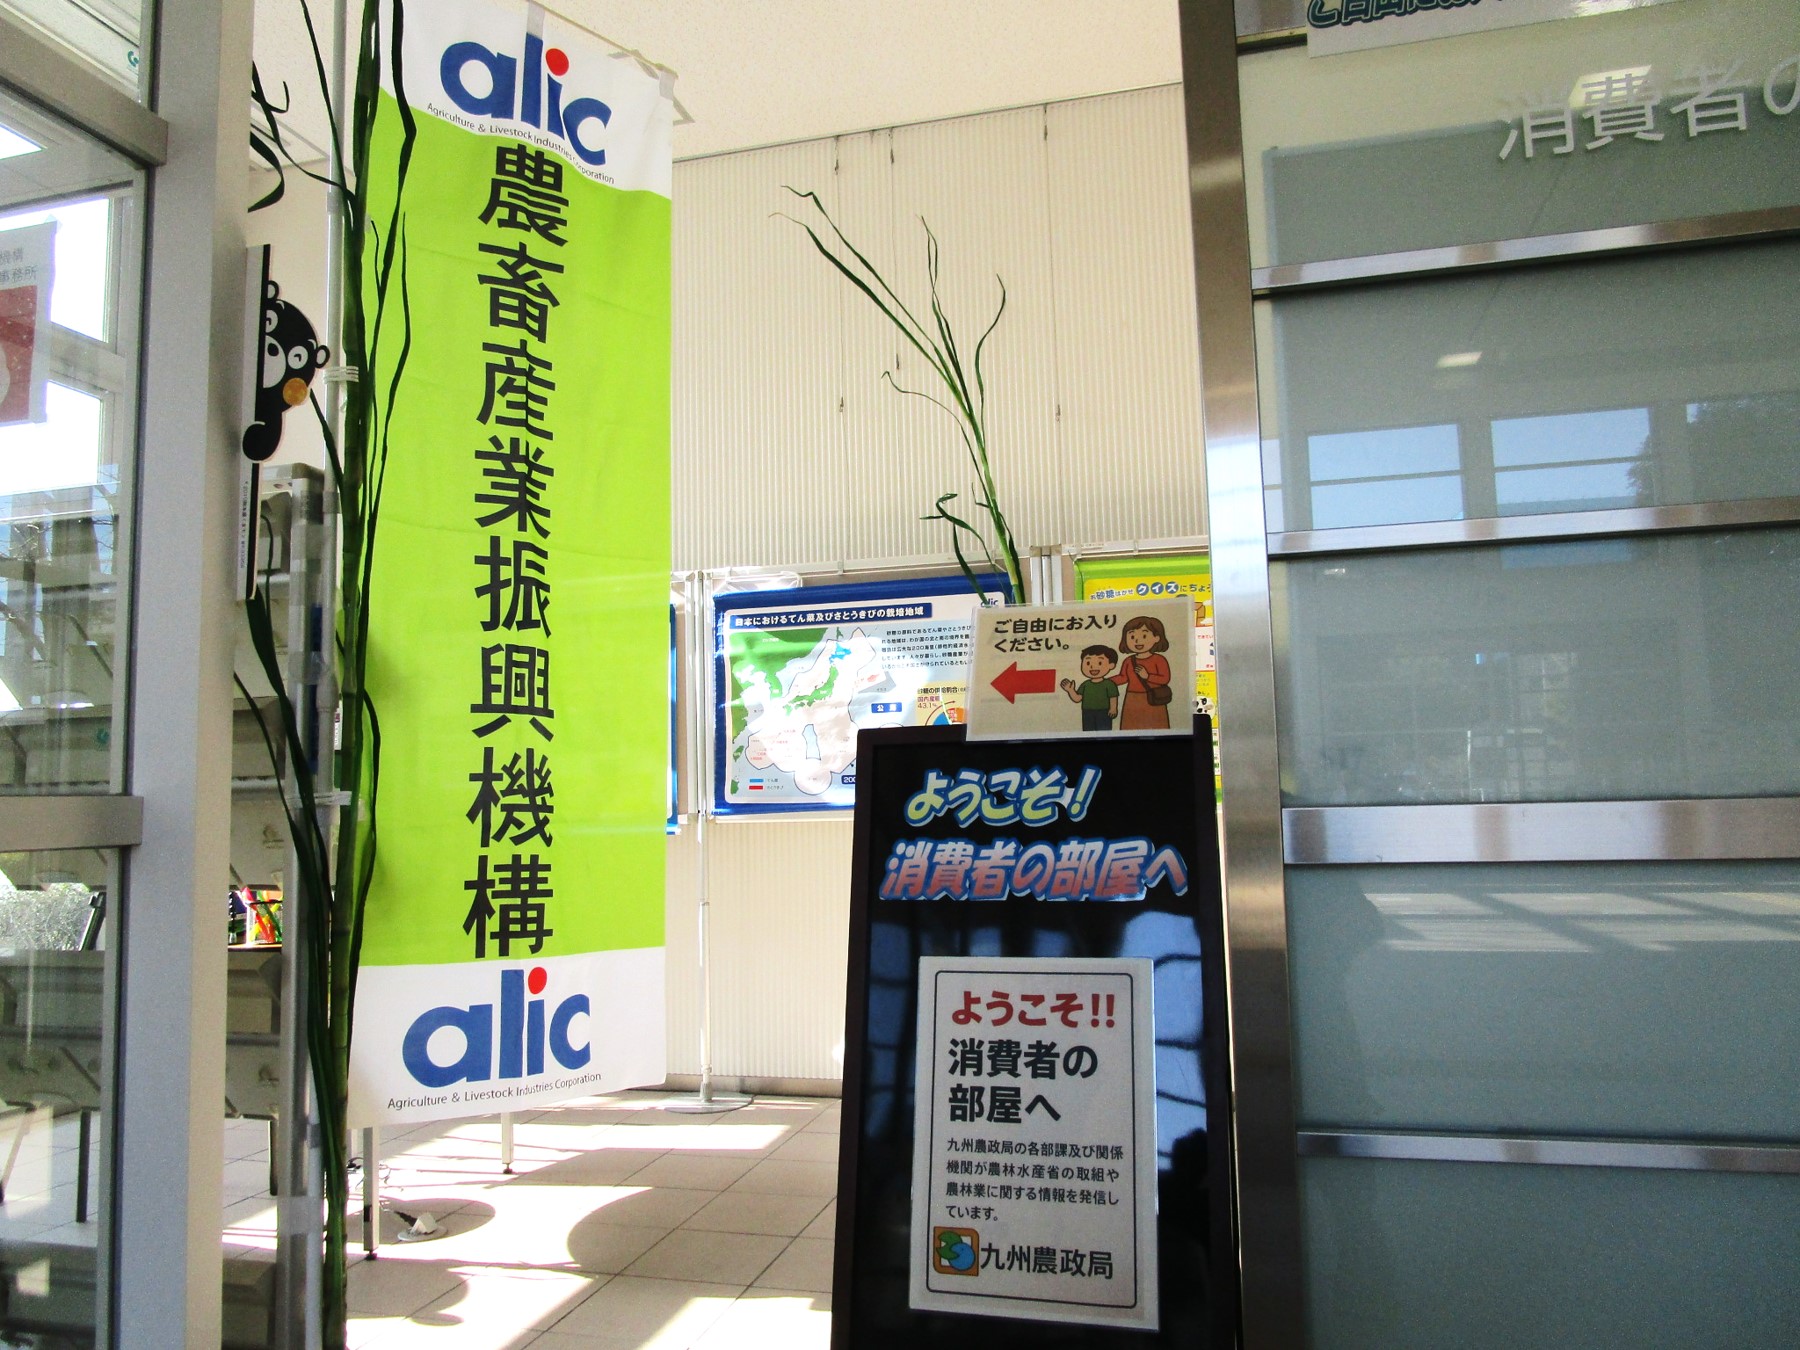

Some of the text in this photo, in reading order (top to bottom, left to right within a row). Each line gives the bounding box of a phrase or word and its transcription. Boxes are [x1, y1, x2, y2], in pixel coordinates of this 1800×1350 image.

[440, 31, 612, 166] alic
[1499, 56, 1800, 161] 消費者の
[427, 102, 475, 132] Agriculture
[478, 124, 486, 133] &
[490, 125, 532, 141] Livestock
[534, 135, 572, 160] Industries
[464, 143, 569, 958] 農畜産業振興機構
[994, 614, 1118, 635] ご自由にお入り
[994, 637, 1071, 653] ください。
[904, 765, 1102, 828] ようこそ!
[879, 837, 1188, 901] 消費者の部屋へ
[402, 966, 591, 1088] alic
[952, 990, 1115, 1028] ようこそ!!
[948, 1038, 1098, 1080] 消費者の
[387, 1072, 602, 1110] Agriculture & Livestock Industries Corporation
[948, 1083, 1062, 1123] 部屋へ
[947, 1138, 1123, 1160] 九州農政局の各部課及び関係
[946, 1161, 1120, 1182] 機関が農林水産省の取組や
[945, 1205, 999, 1221] ています。
[946, 1182, 1120, 1205] 農林業に関する情報を発信し
[980, 1243, 1114, 1280] 九州農政局
